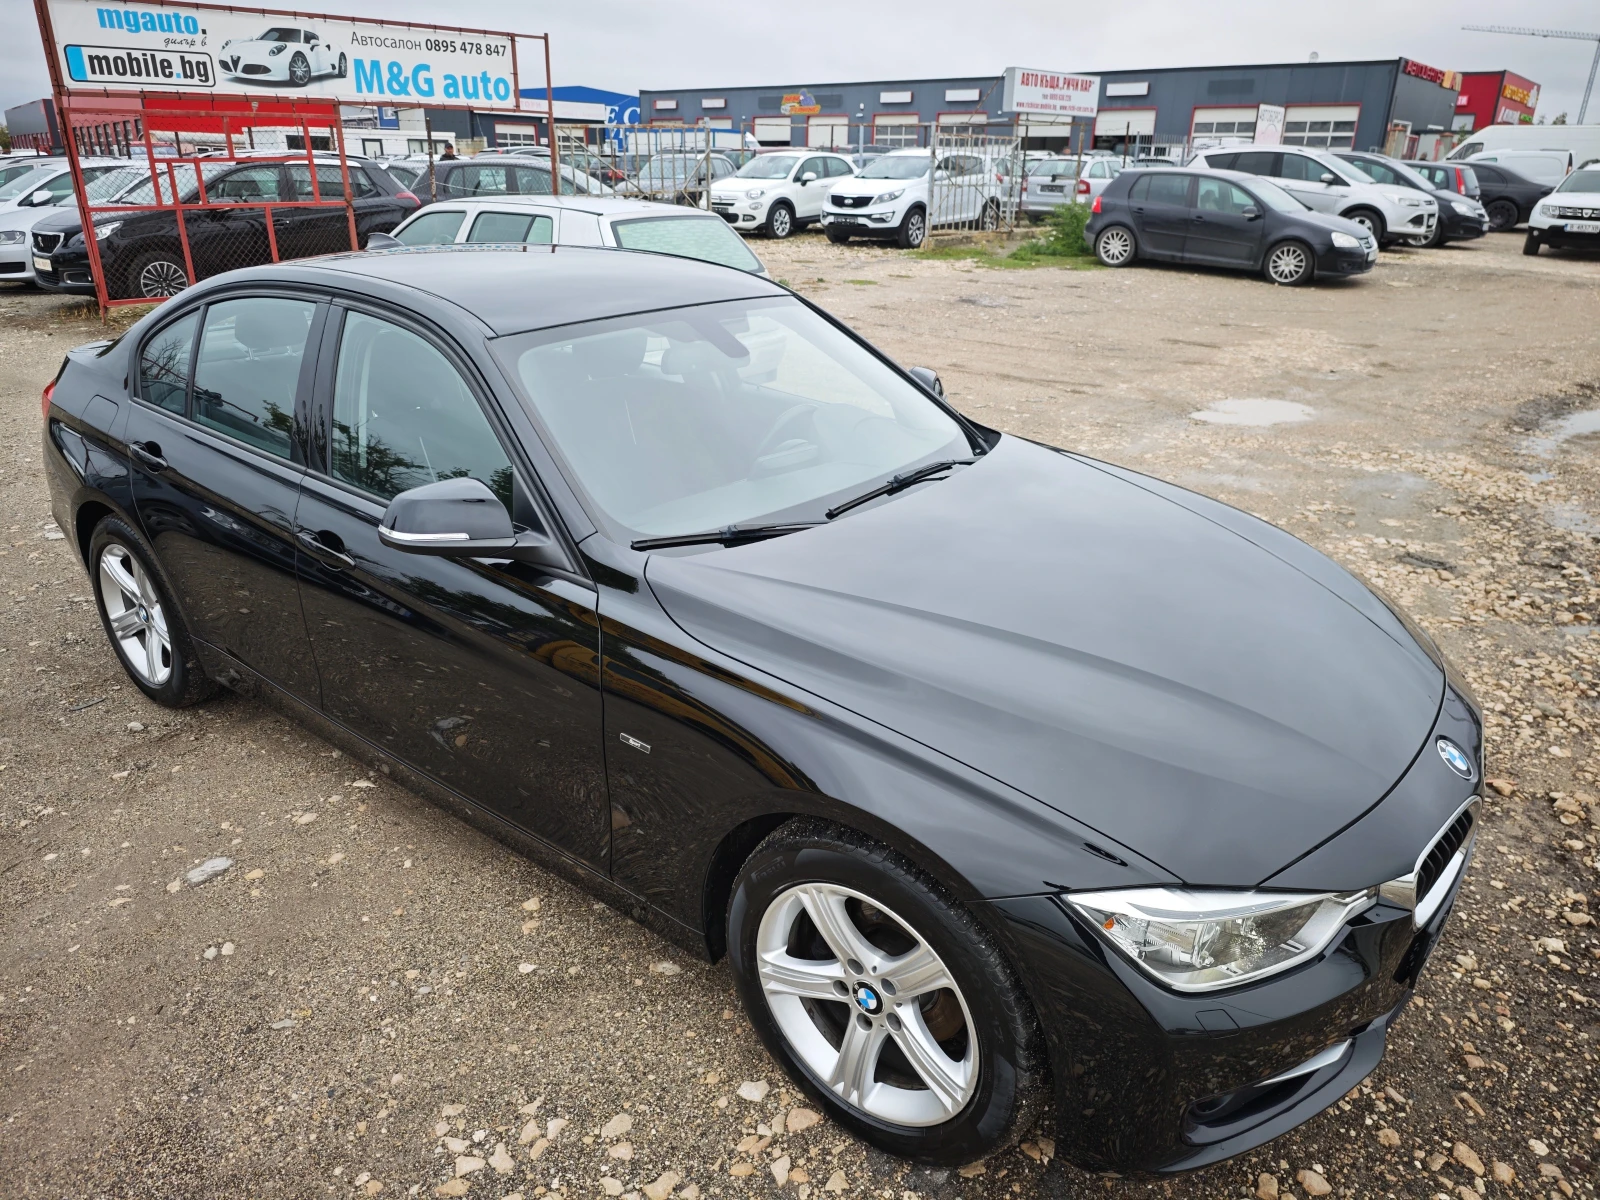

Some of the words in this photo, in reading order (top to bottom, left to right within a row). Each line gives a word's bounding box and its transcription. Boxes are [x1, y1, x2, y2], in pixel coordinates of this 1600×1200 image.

[351, 31, 422, 50] Автосалон
[425, 38, 456, 53] 0895
[460, 42, 482, 55] 478
[485, 43, 507, 57] 847
[88, 52, 210, 83] mobile.bg
[353, 58, 435, 97] M&G
[443, 70, 510, 101] auto
[1021, 72, 1039, 87] АВТО
[1040, 74, 1060, 91] КЪЩА
